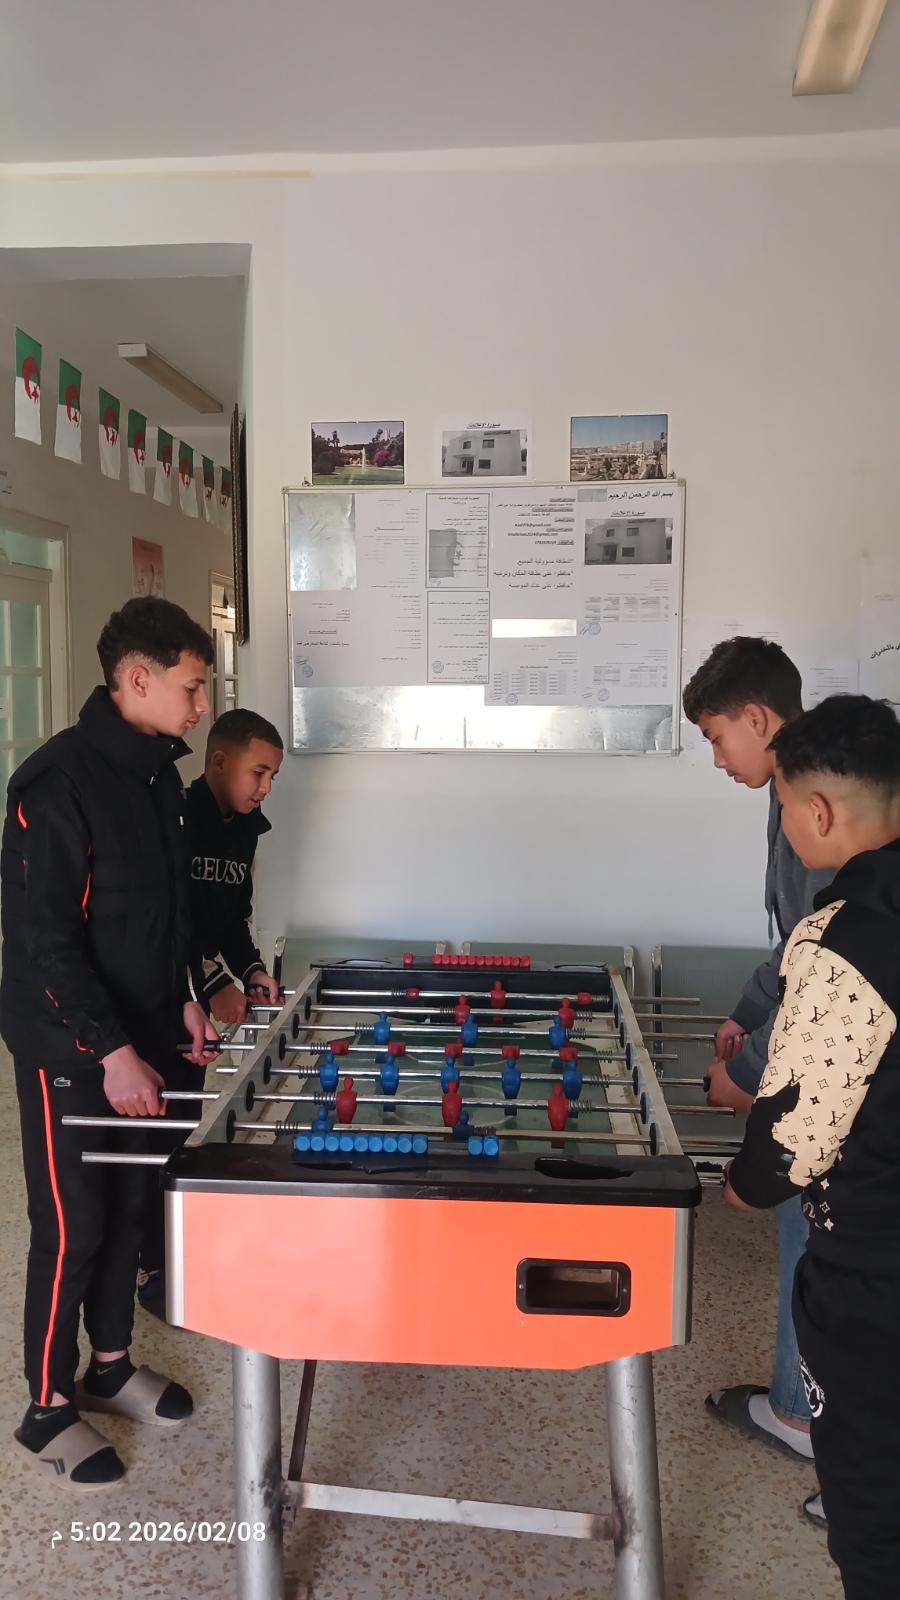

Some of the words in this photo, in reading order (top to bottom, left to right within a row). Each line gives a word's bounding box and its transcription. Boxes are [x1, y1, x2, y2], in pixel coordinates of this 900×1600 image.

[607, 491, 628, 501] الرحيم
[628, 490, 650, 500] الرحمن
[651, 490, 661, 498] الله
[660, 491, 674, 500] بسم
[191, 856, 247, 885] GEUSS
